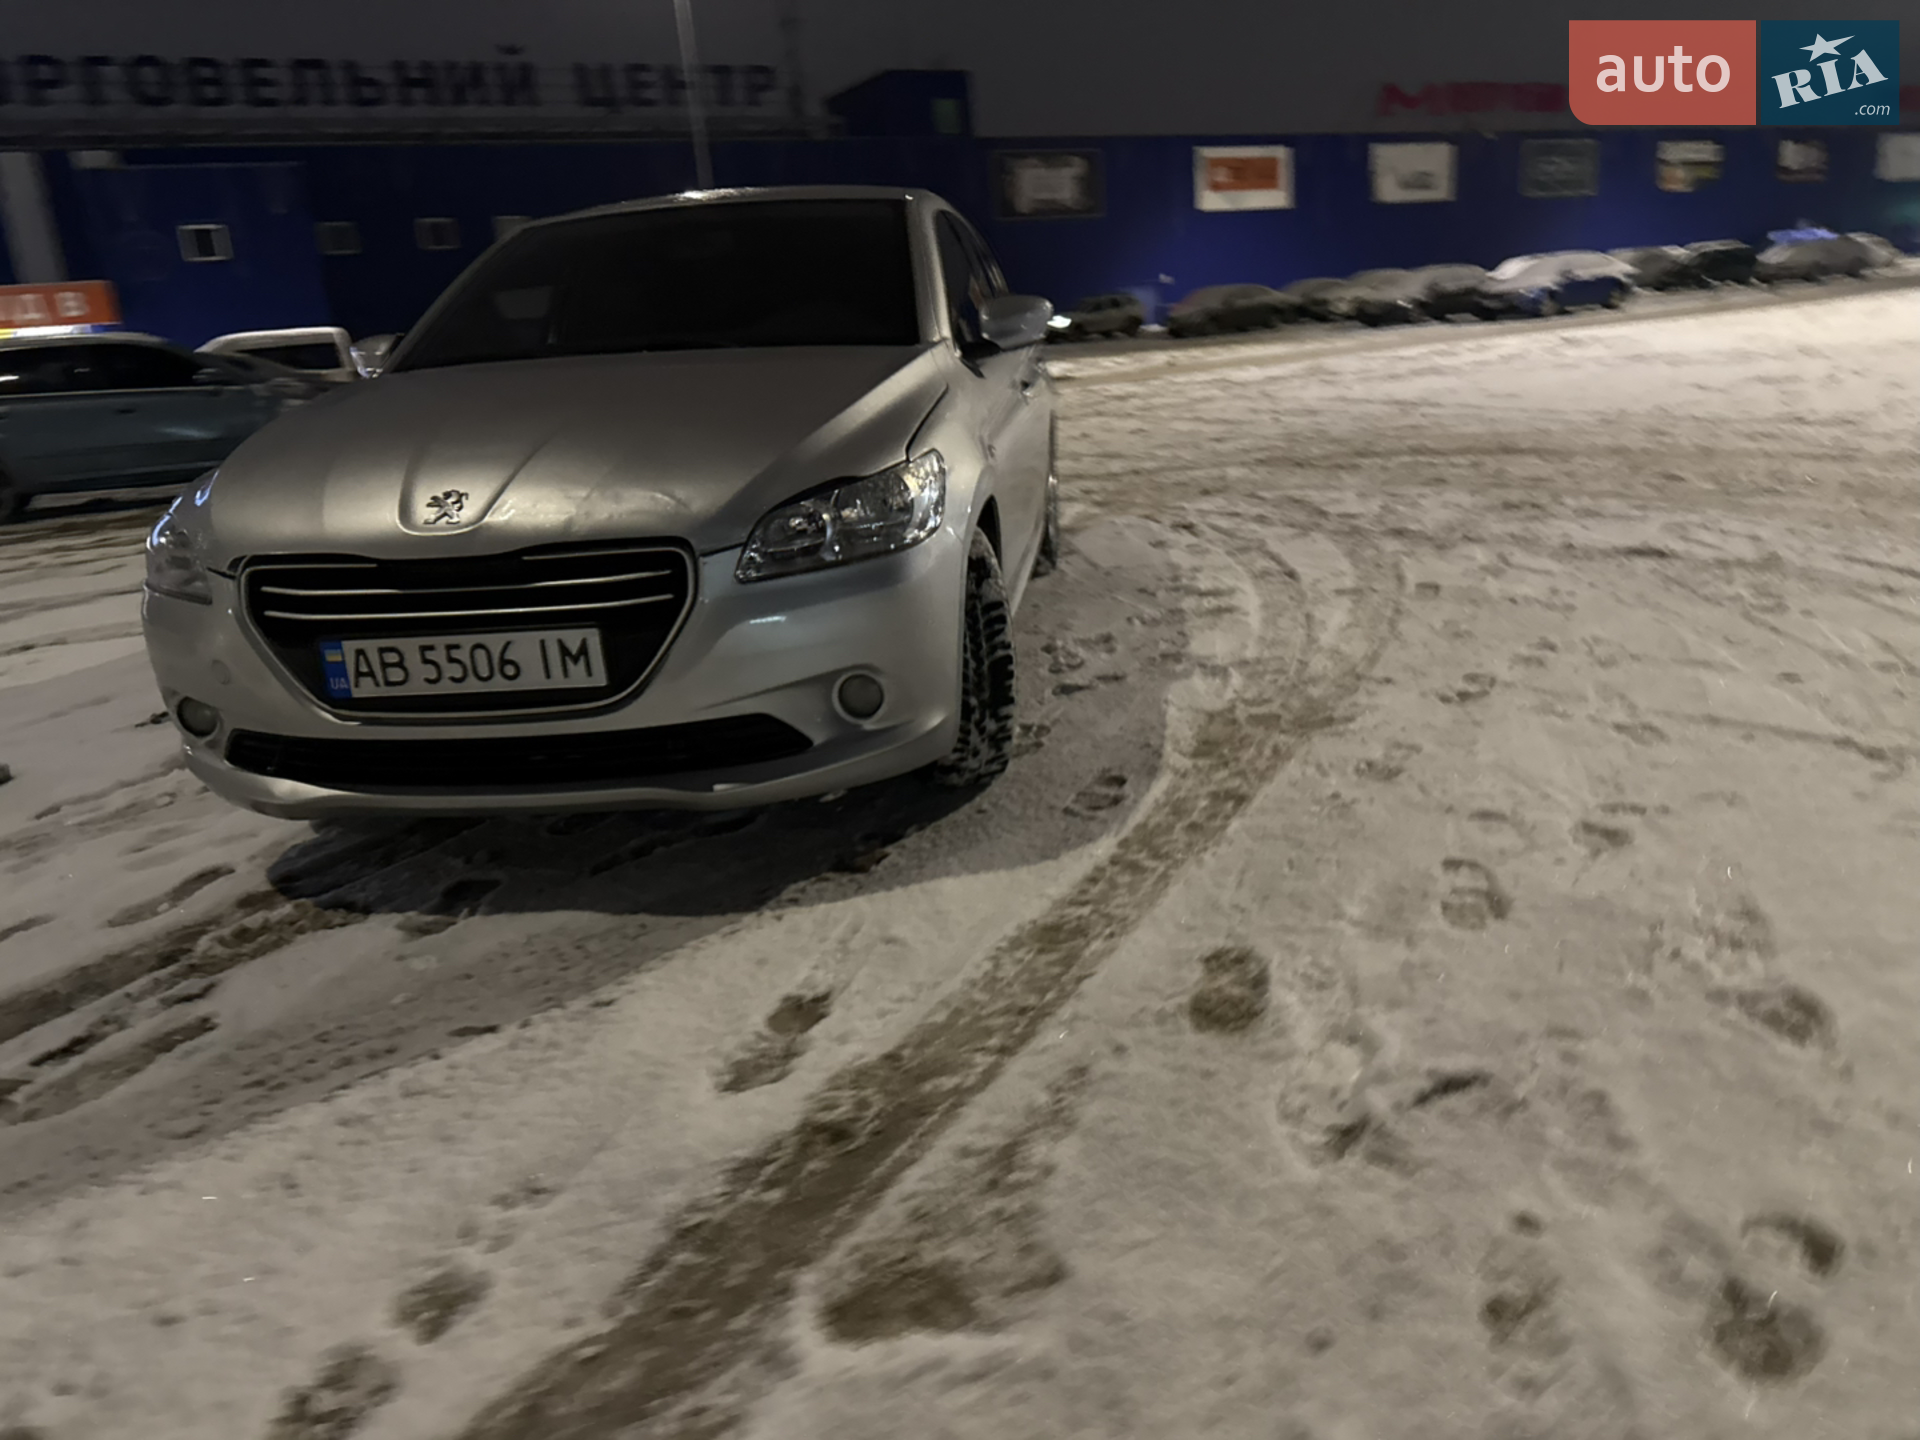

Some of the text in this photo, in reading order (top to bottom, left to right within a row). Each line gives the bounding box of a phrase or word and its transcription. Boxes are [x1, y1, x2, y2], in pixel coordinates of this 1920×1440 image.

[572, 62, 776, 114] ЦЕНТР
[330, 679, 348, 689] UA
[354, 637, 593, 688] AB 5506 IM
